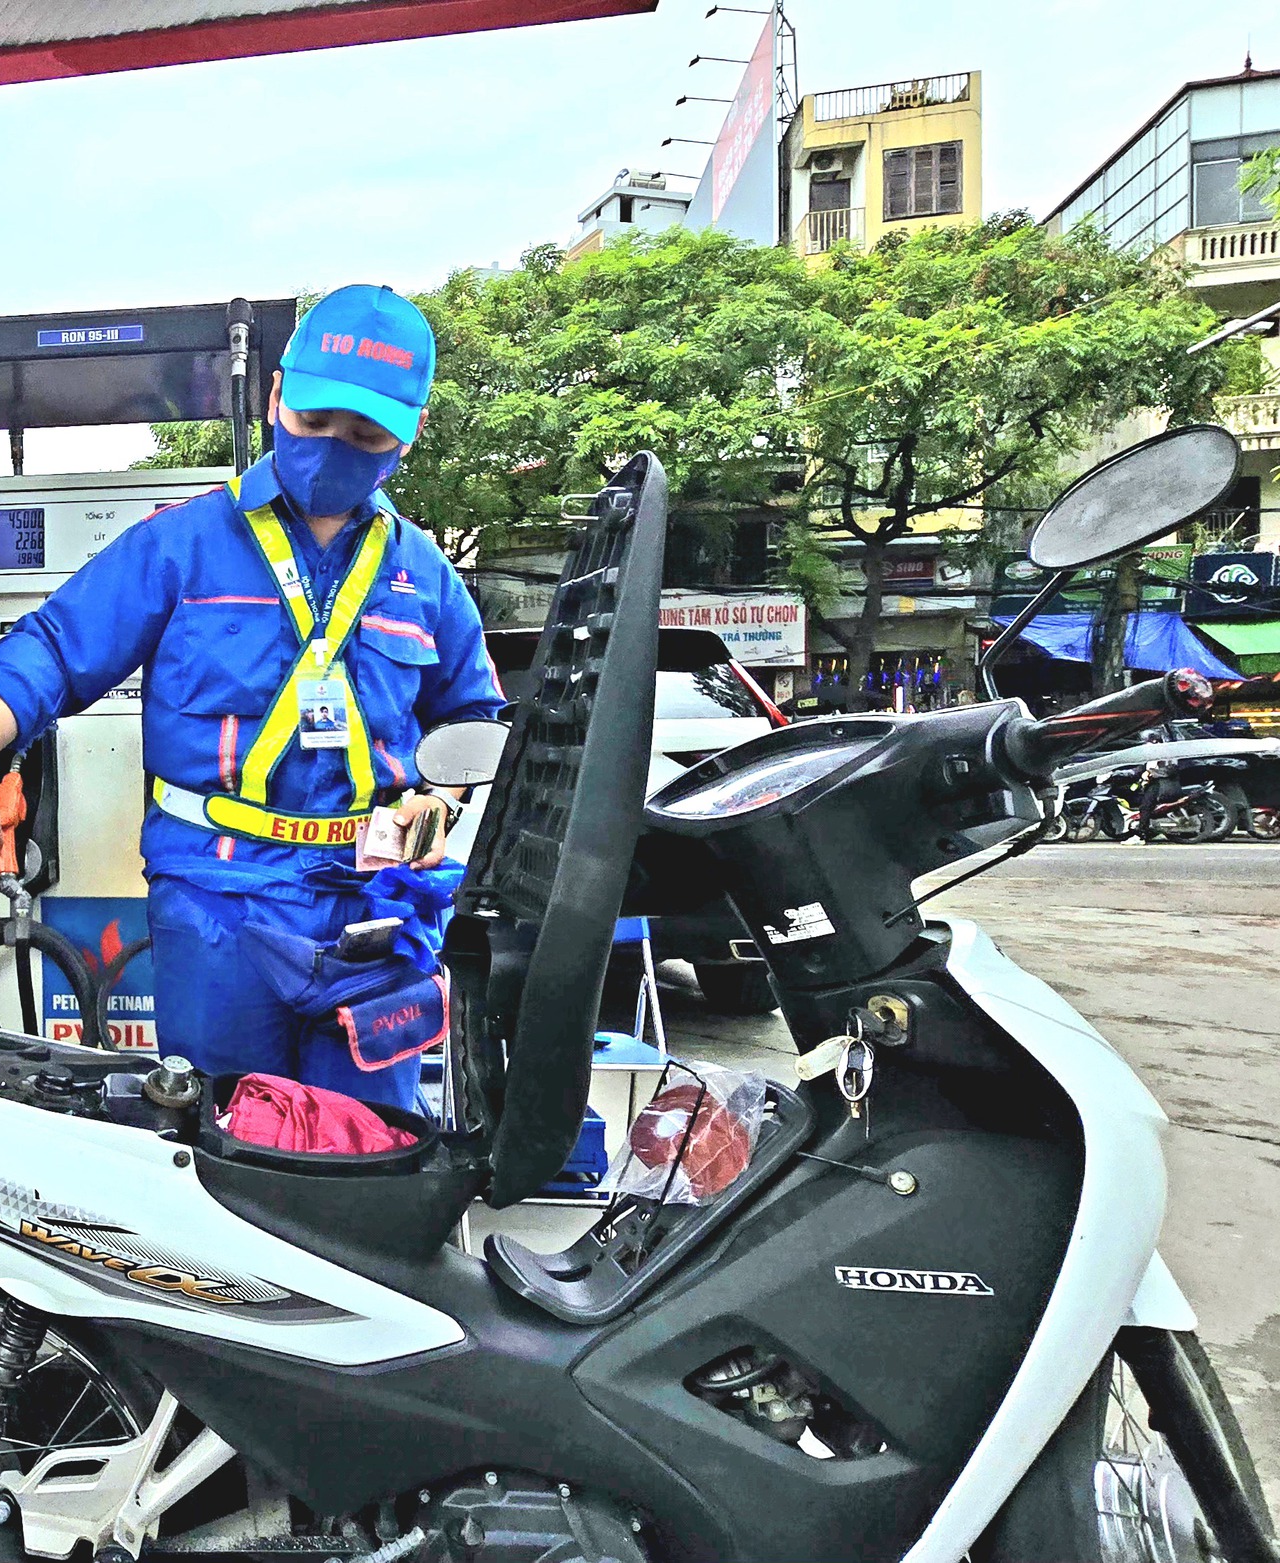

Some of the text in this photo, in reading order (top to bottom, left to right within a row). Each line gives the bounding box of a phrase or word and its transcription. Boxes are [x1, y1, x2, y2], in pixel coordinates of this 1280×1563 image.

[61, 329, 118, 343] RON 95-III
[321, 333, 354, 355] E10
[271, 817, 370, 842] E10 RO
[372, 1003, 422, 1035] PVOIL
[21, 1220, 135, 1271] WAVE
[837, 1268, 992, 1294] HONDA
